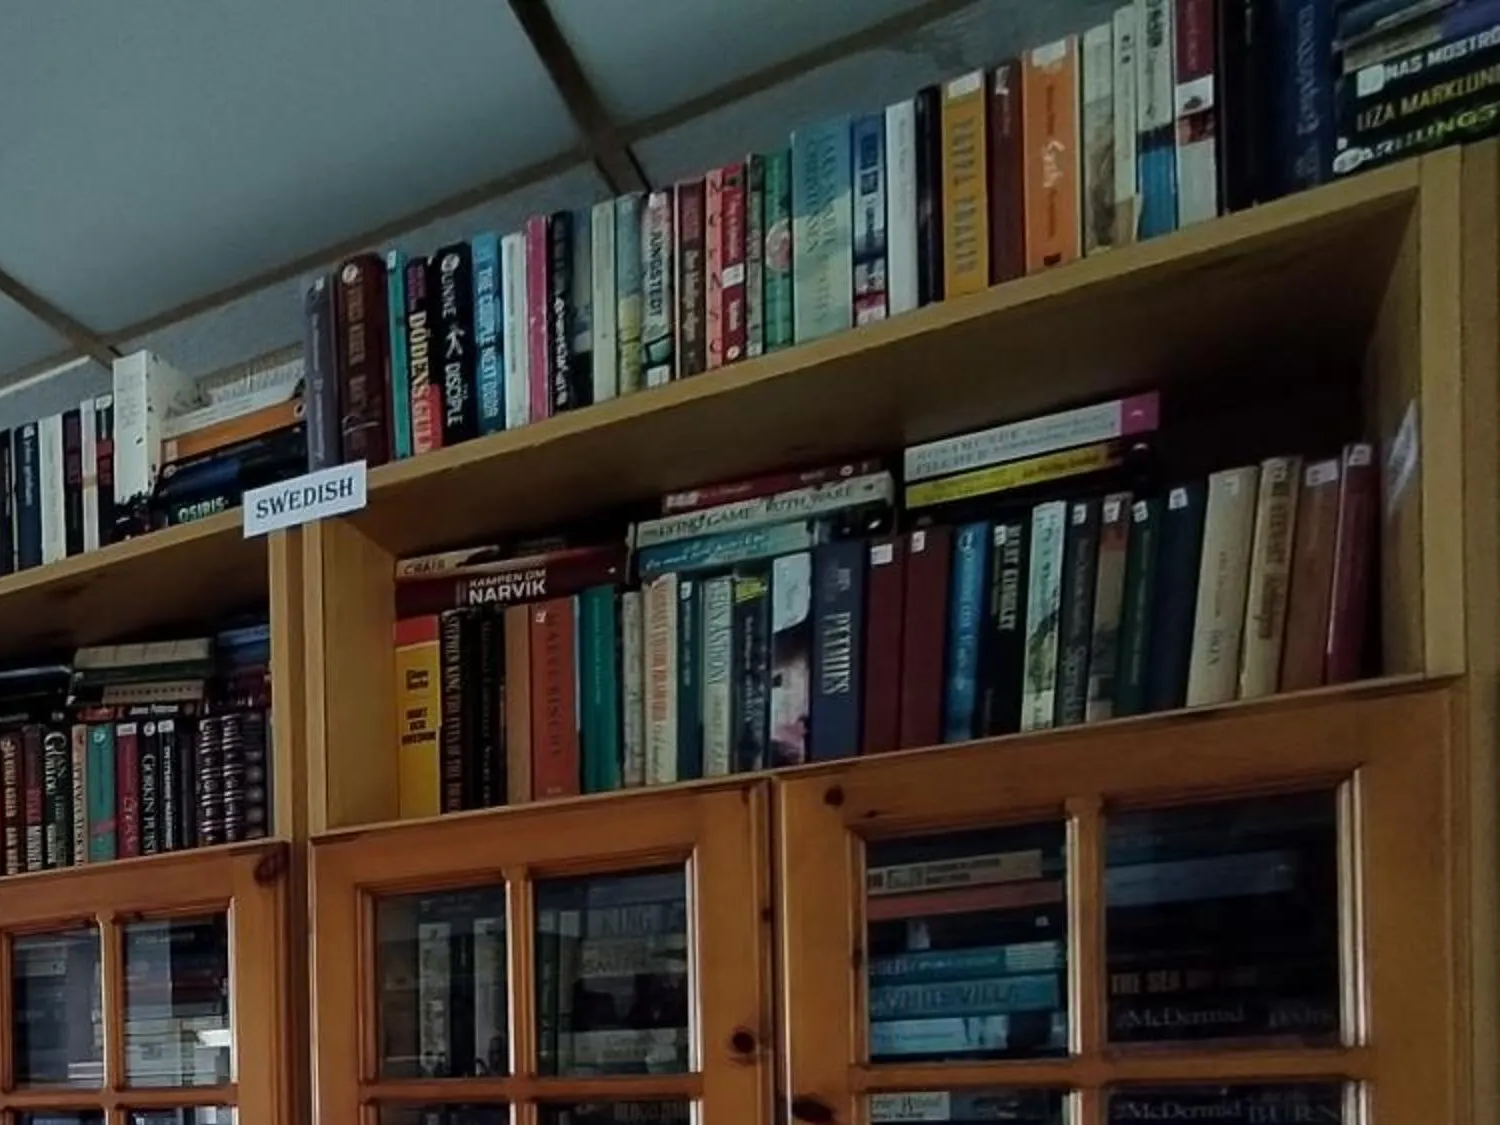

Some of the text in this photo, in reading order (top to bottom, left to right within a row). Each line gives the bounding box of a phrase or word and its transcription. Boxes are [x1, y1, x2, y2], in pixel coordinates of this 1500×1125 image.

[408, 310, 434, 398] DÖDENS
[255, 477, 354, 520] SWEDISH
[468, 578, 547, 606] NARVIK
[445, 664, 463, 694] KING
